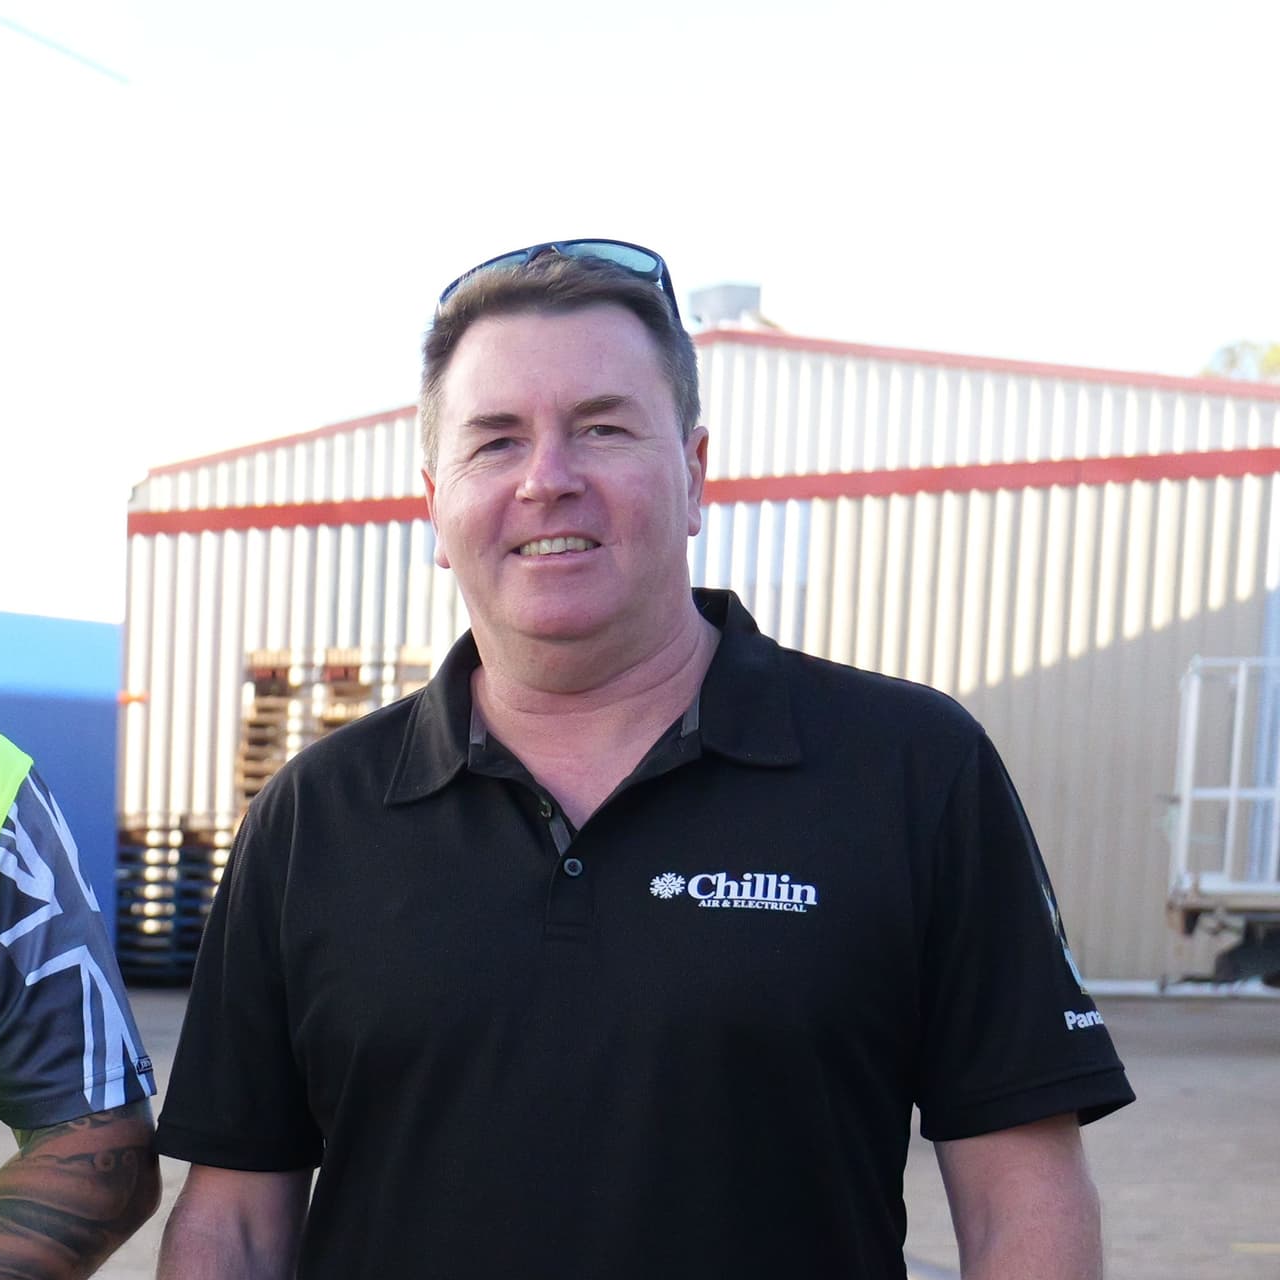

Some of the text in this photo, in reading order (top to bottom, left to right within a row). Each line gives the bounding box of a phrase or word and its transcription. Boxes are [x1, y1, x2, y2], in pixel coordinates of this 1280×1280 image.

[687, 872, 818, 905] Chillin
[697, 899, 807, 913] AIR & ELECTRICAL
